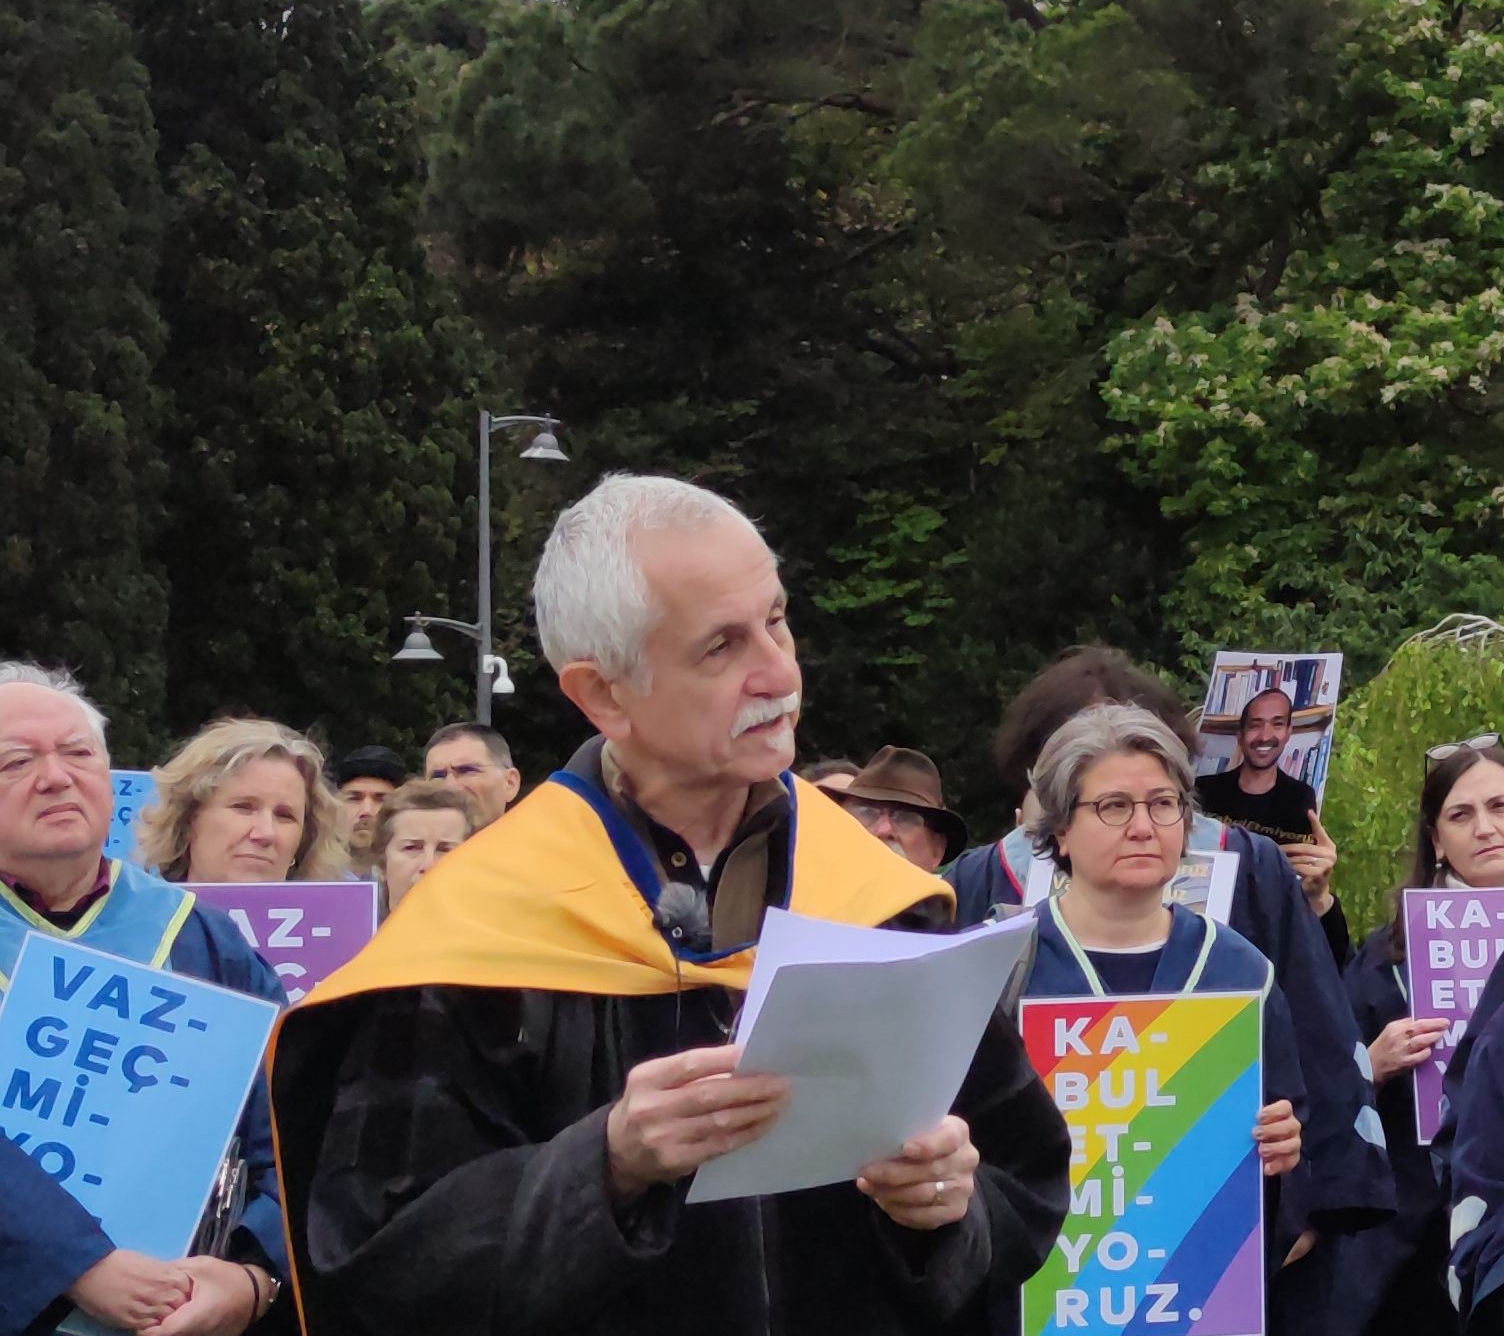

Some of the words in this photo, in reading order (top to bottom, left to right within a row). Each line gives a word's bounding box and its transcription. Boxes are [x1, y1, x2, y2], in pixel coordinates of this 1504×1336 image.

[52, 955, 209, 1035] VAZ-
[1430, 978, 1486, 1010] ET
[25, 1015, 191, 1094] GEÇ-
[1053, 1015, 1169, 1057] KA-
[2, 1067, 111, 1128] Mİ-
[1054, 1068, 1177, 1112] BUL
[1056, 1231, 1166, 1274] YO-
[1055, 1282, 1203, 1329] RUZ.
